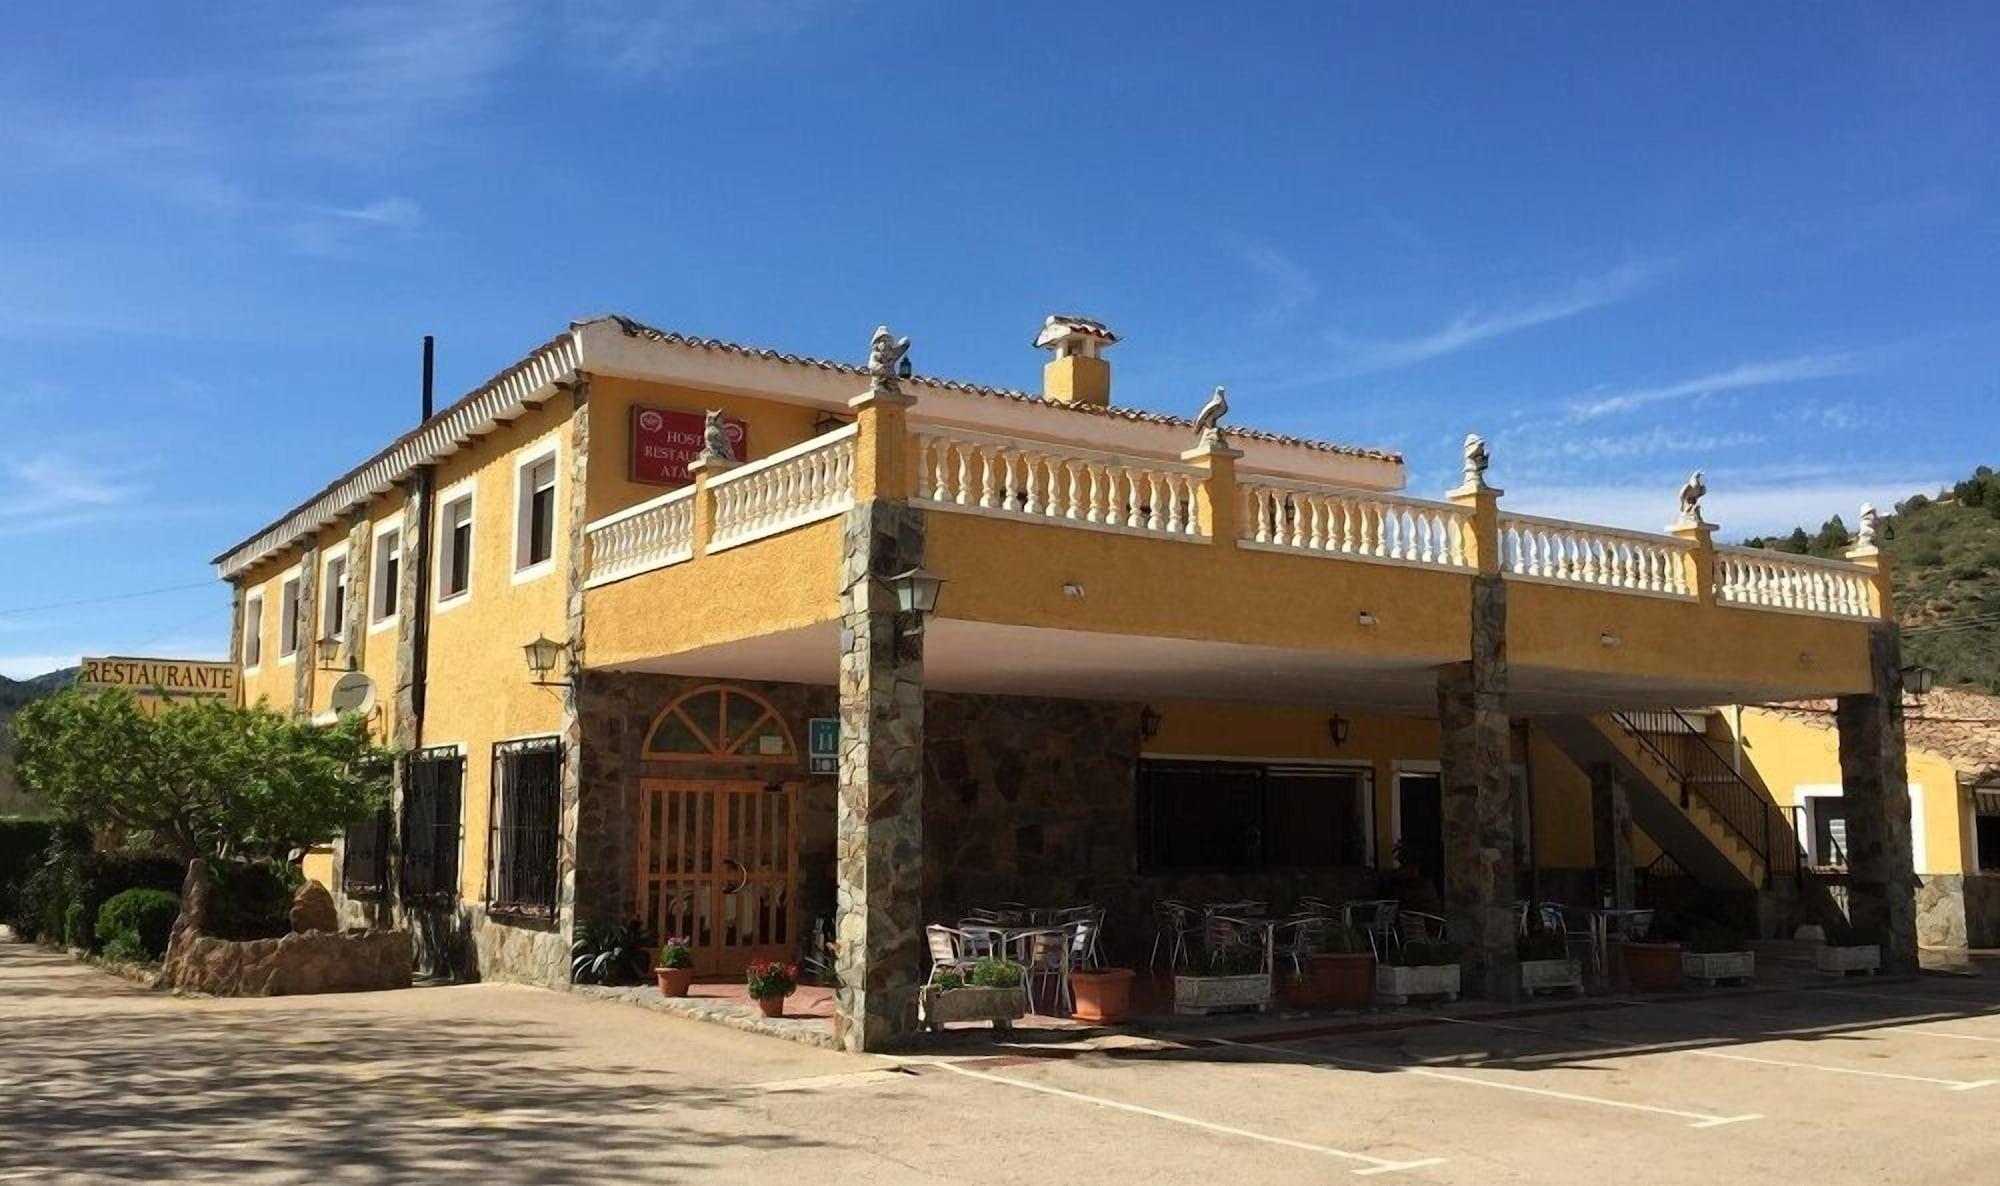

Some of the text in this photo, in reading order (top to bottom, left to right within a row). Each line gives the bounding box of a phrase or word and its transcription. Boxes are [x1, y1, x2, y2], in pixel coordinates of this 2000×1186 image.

[666, 431, 704, 447] HOST
[660, 465, 689, 479] ATA
[86, 661, 233, 689] RESTAURANTE
